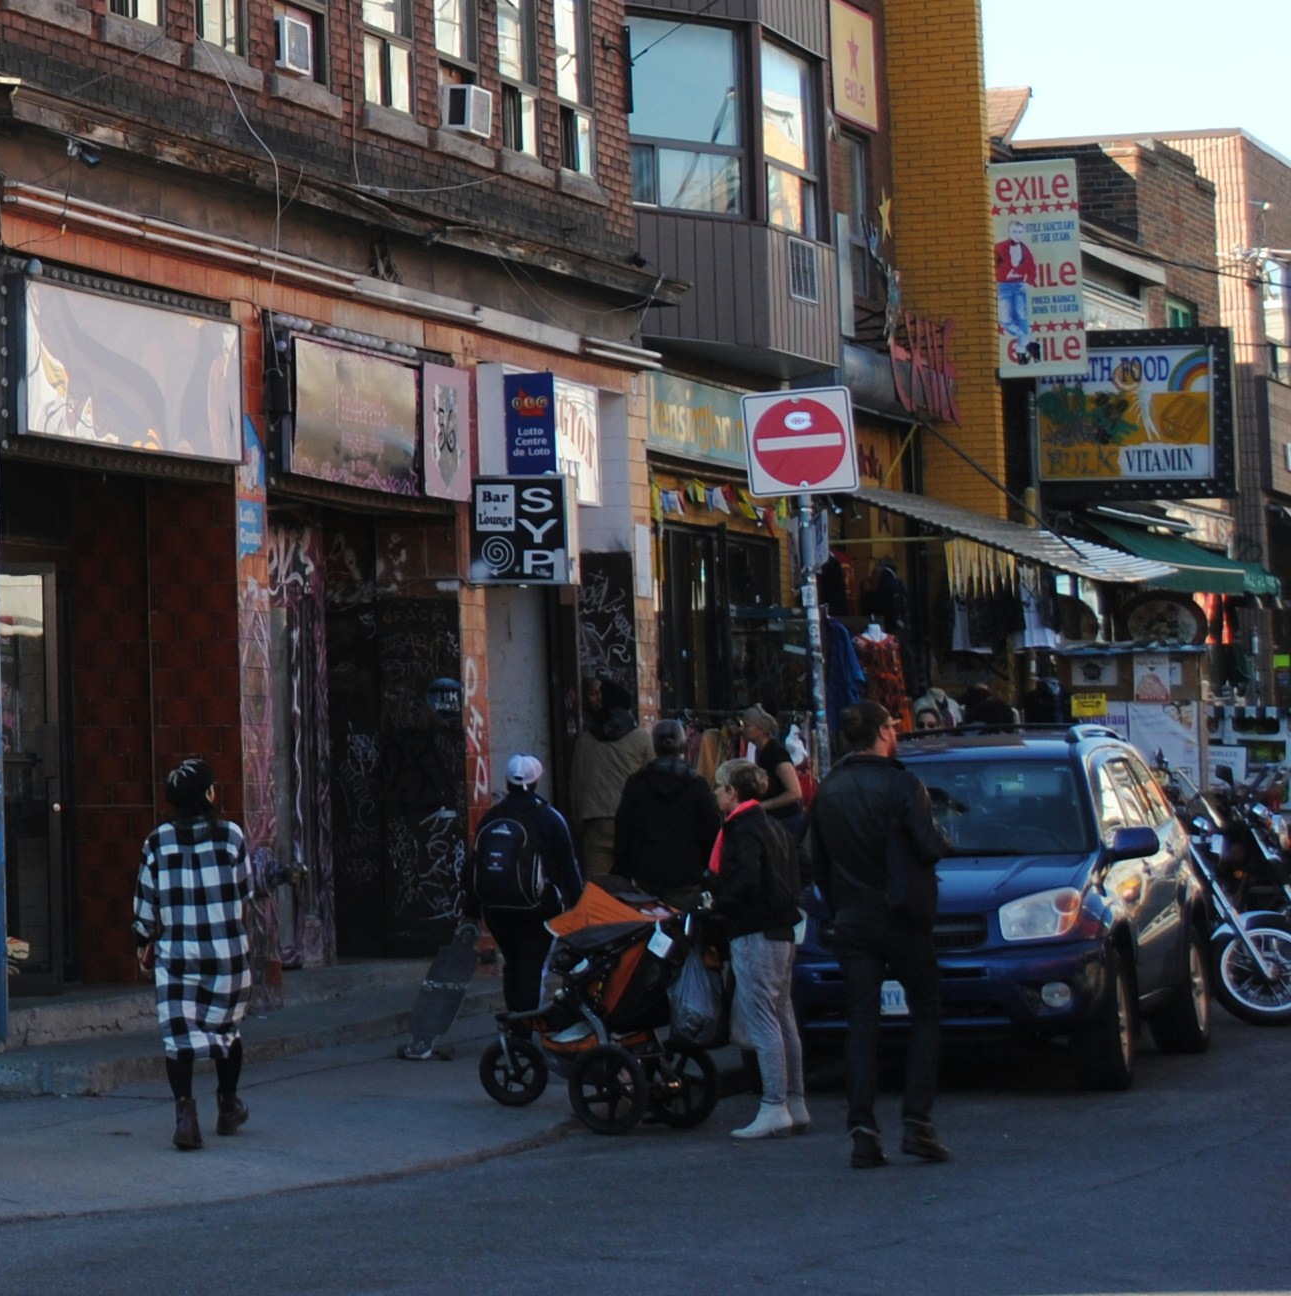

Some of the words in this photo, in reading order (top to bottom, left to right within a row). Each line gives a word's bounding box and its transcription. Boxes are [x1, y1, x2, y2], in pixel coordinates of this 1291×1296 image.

[1121, 356, 1171, 382] FOOD
[517, 427, 544, 437] Lotto
[515, 436, 547, 447] Centre
[512, 447, 525, 457] de
[528, 447, 551, 457] Loto
[1125, 447, 1194, 474] VITAMIN
[482, 490, 509, 503] Bar
